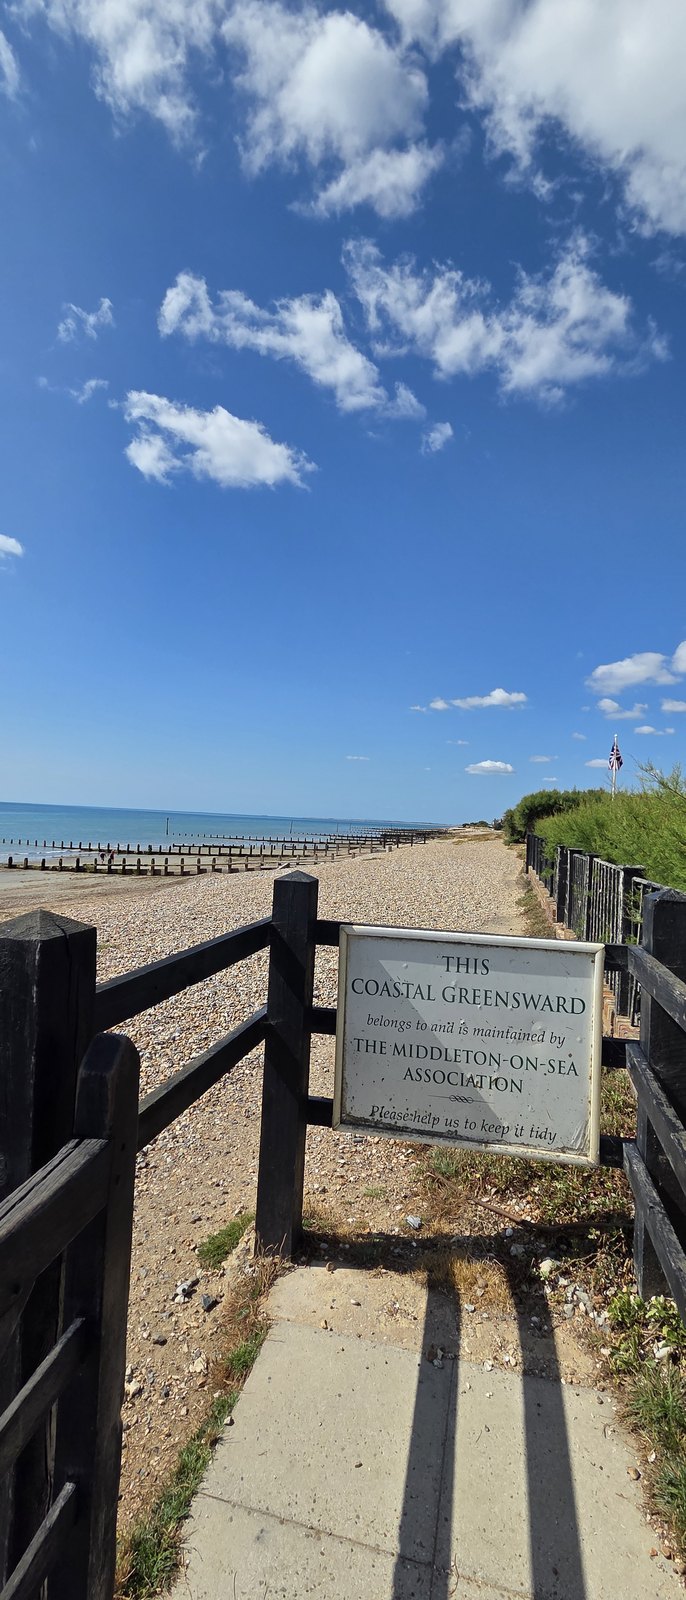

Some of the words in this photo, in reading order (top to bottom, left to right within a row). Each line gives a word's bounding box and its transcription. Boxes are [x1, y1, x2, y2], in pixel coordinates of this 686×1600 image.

[442, 956, 490, 975] THIS
[351, 978, 436, 1001] COASTAL
[442, 986, 586, 1015] GREENSWARD
[367, 1014, 412, 1032] belongs
[415, 1020, 428, 1031] to
[430, 1022, 454, 1035] and
[459, 1023, 469, 1035] is
[473, 1025, 545, 1043] maintained
[549, 1032, 566, 1048] by
[353, 1038, 387, 1055] THE
[392, 1043, 579, 1076] MIDDLETON-ON-SEA
[403, 1067, 523, 1093] ASSOCIATION
[369, 1105, 410, 1121] Please
[413, 1109, 439, 1128] help
[444, 1117, 460, 1128] us
[464, 1118, 477, 1130] to
[481, 1120, 510, 1137] keep
[514, 1124, 524, 1137] it
[529, 1126, 557, 1145] tidy
